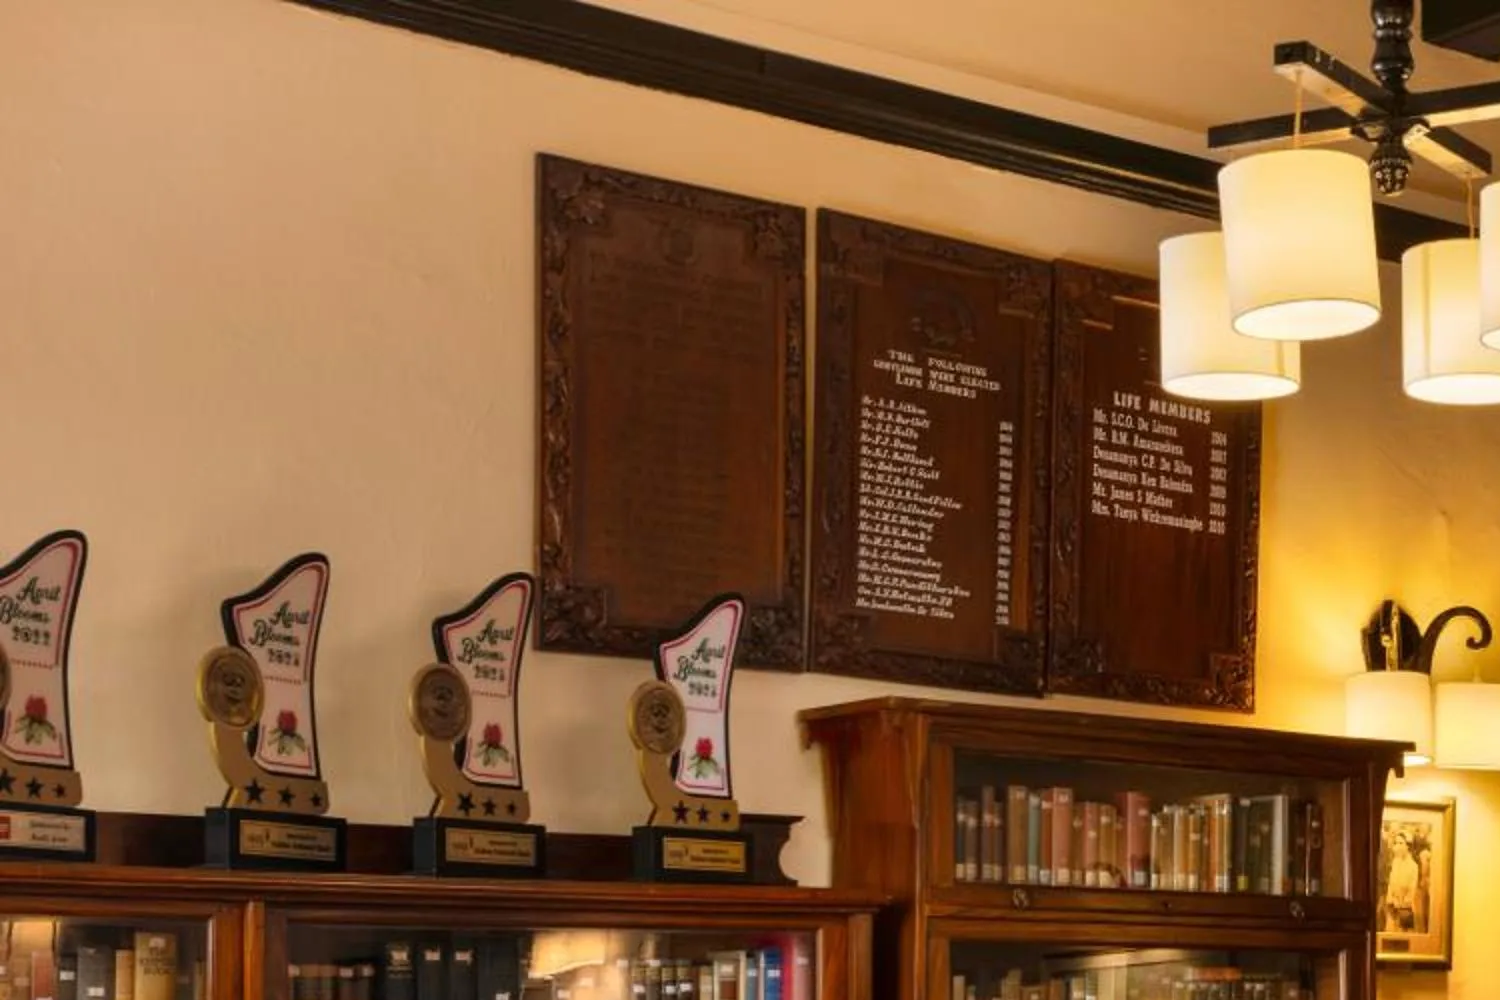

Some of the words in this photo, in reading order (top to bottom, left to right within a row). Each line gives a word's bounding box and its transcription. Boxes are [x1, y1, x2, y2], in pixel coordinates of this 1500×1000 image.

[1113, 390, 1142, 411] LIFE
[1149, 397, 1211, 425] MEMBERS
[16, 576, 60, 603] April
[268, 601, 310, 629] April
[475, 619, 515, 645] April
[690, 637, 726, 663] April
